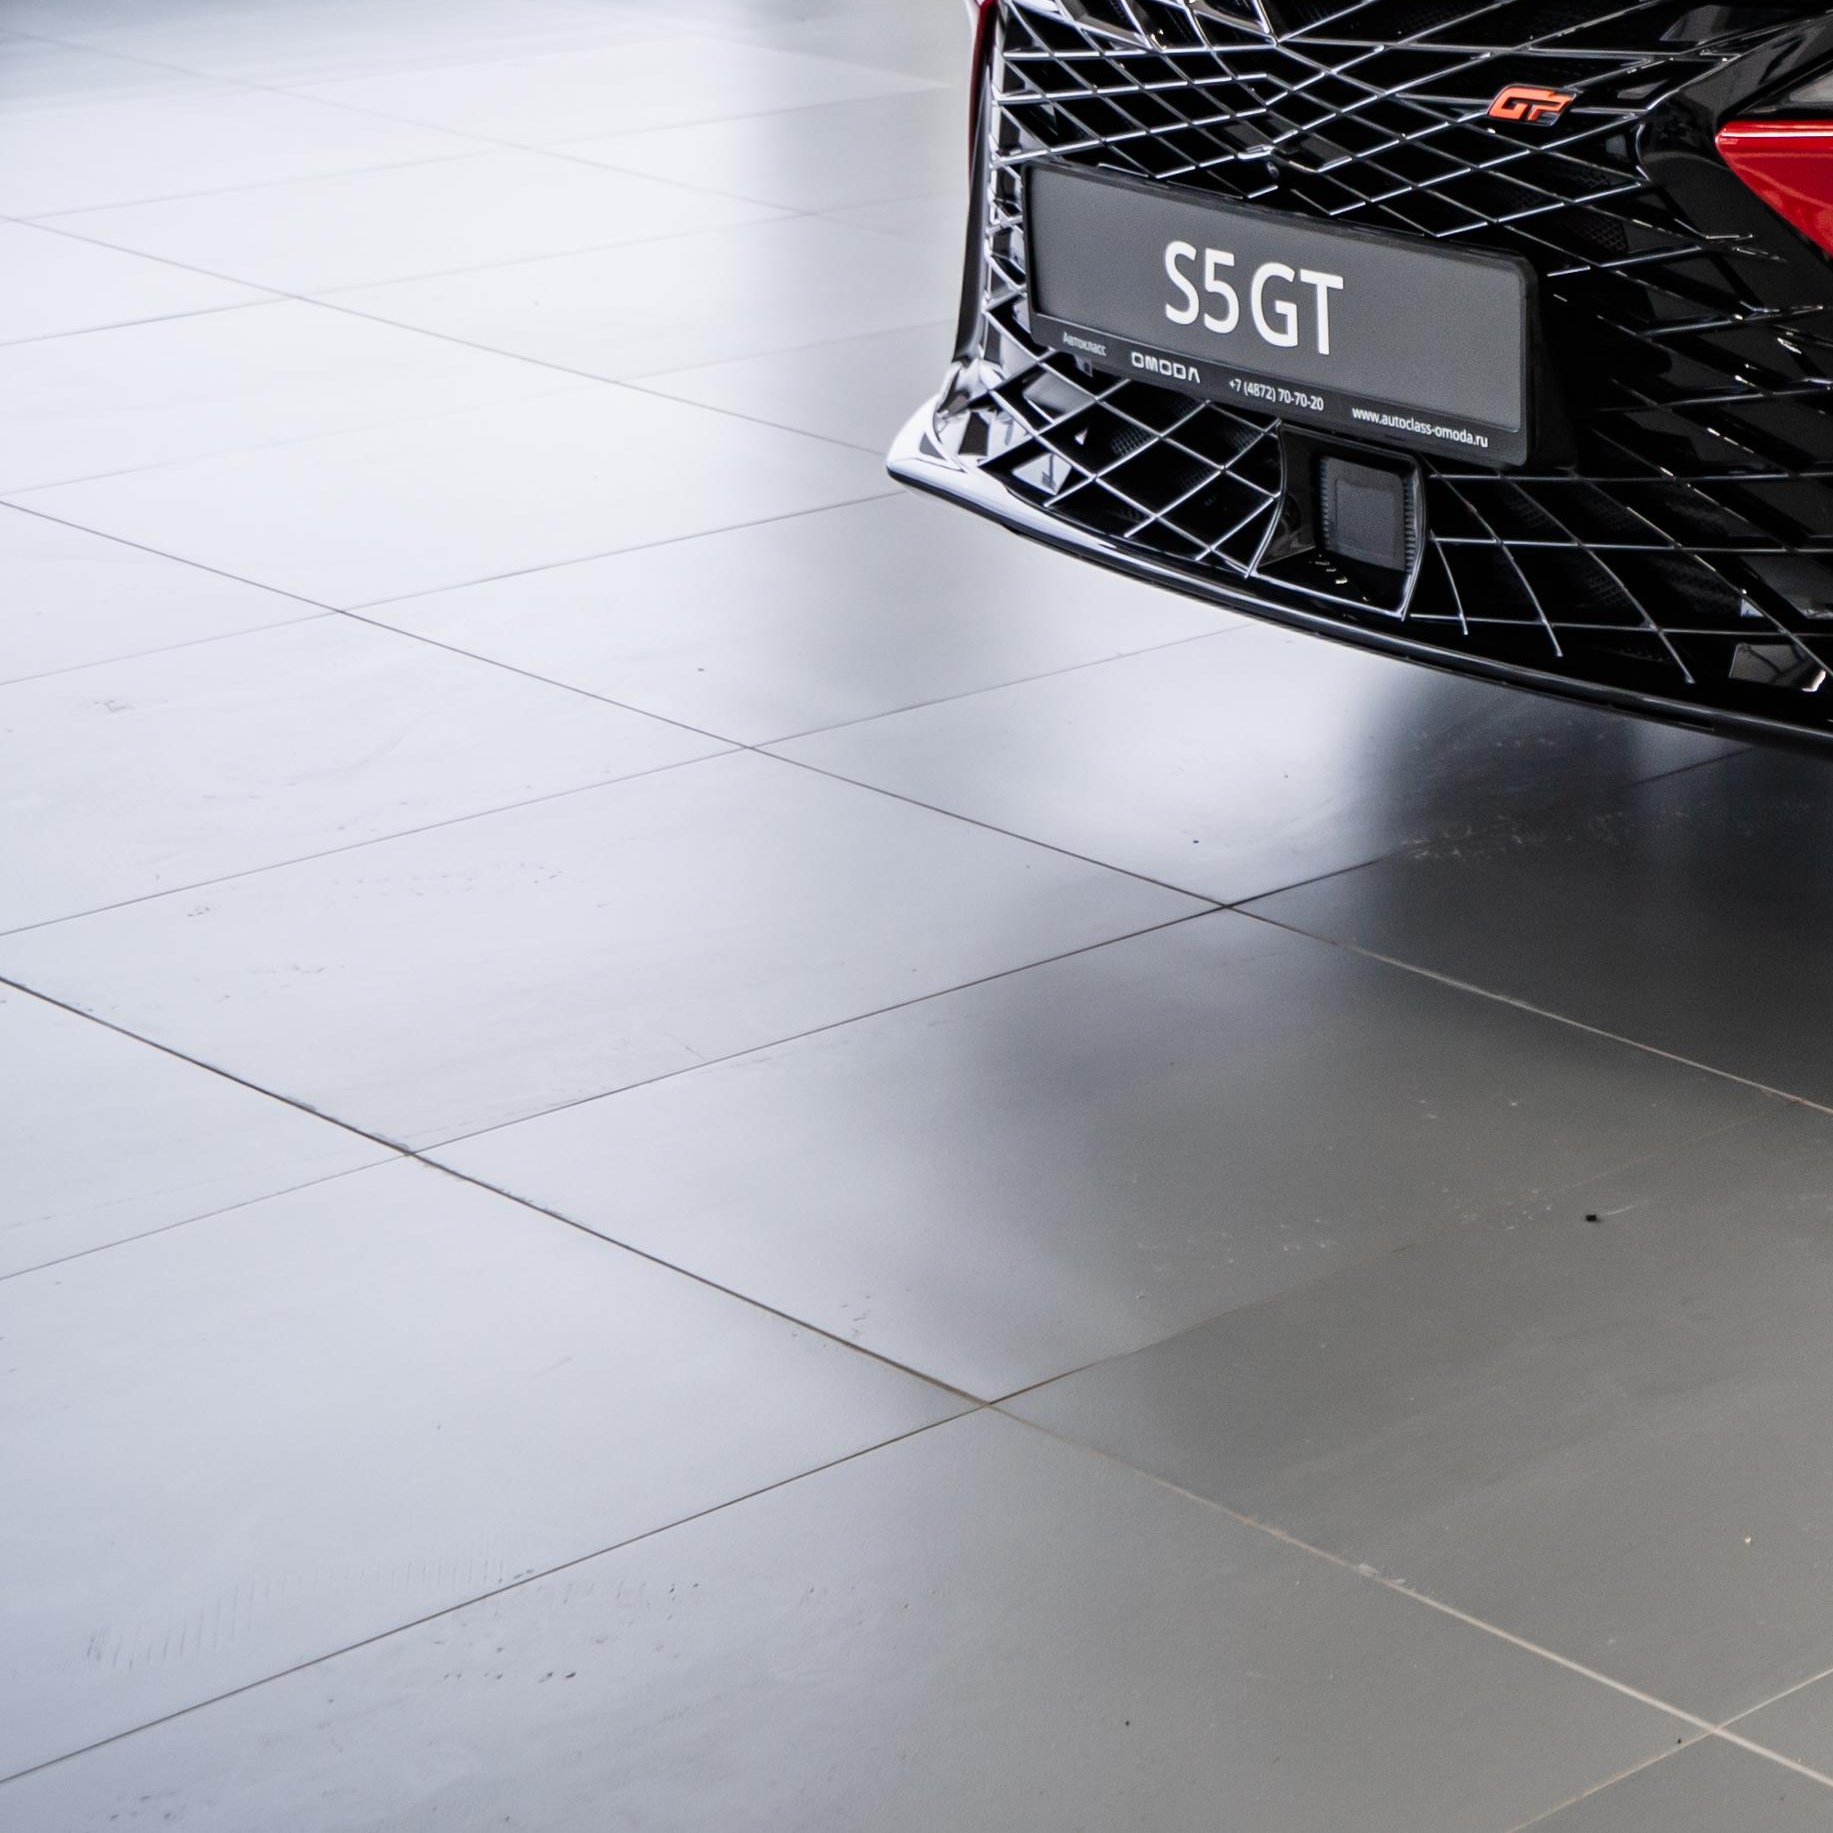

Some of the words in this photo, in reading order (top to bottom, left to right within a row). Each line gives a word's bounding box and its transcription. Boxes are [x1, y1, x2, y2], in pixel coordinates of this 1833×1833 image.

[1489, 84, 1576, 123] GT
[1164, 240, 1240, 334] S5
[1250, 262, 1344, 356] GT
[1131, 351, 1201, 384] OMODA
[1229, 378, 1241, 393] +7
[1243, 380, 1277, 403] (4872)
[1278, 388, 1325, 412] 70-70-20
[1352, 407, 1489, 448] www.autoclass-omoda.ru
